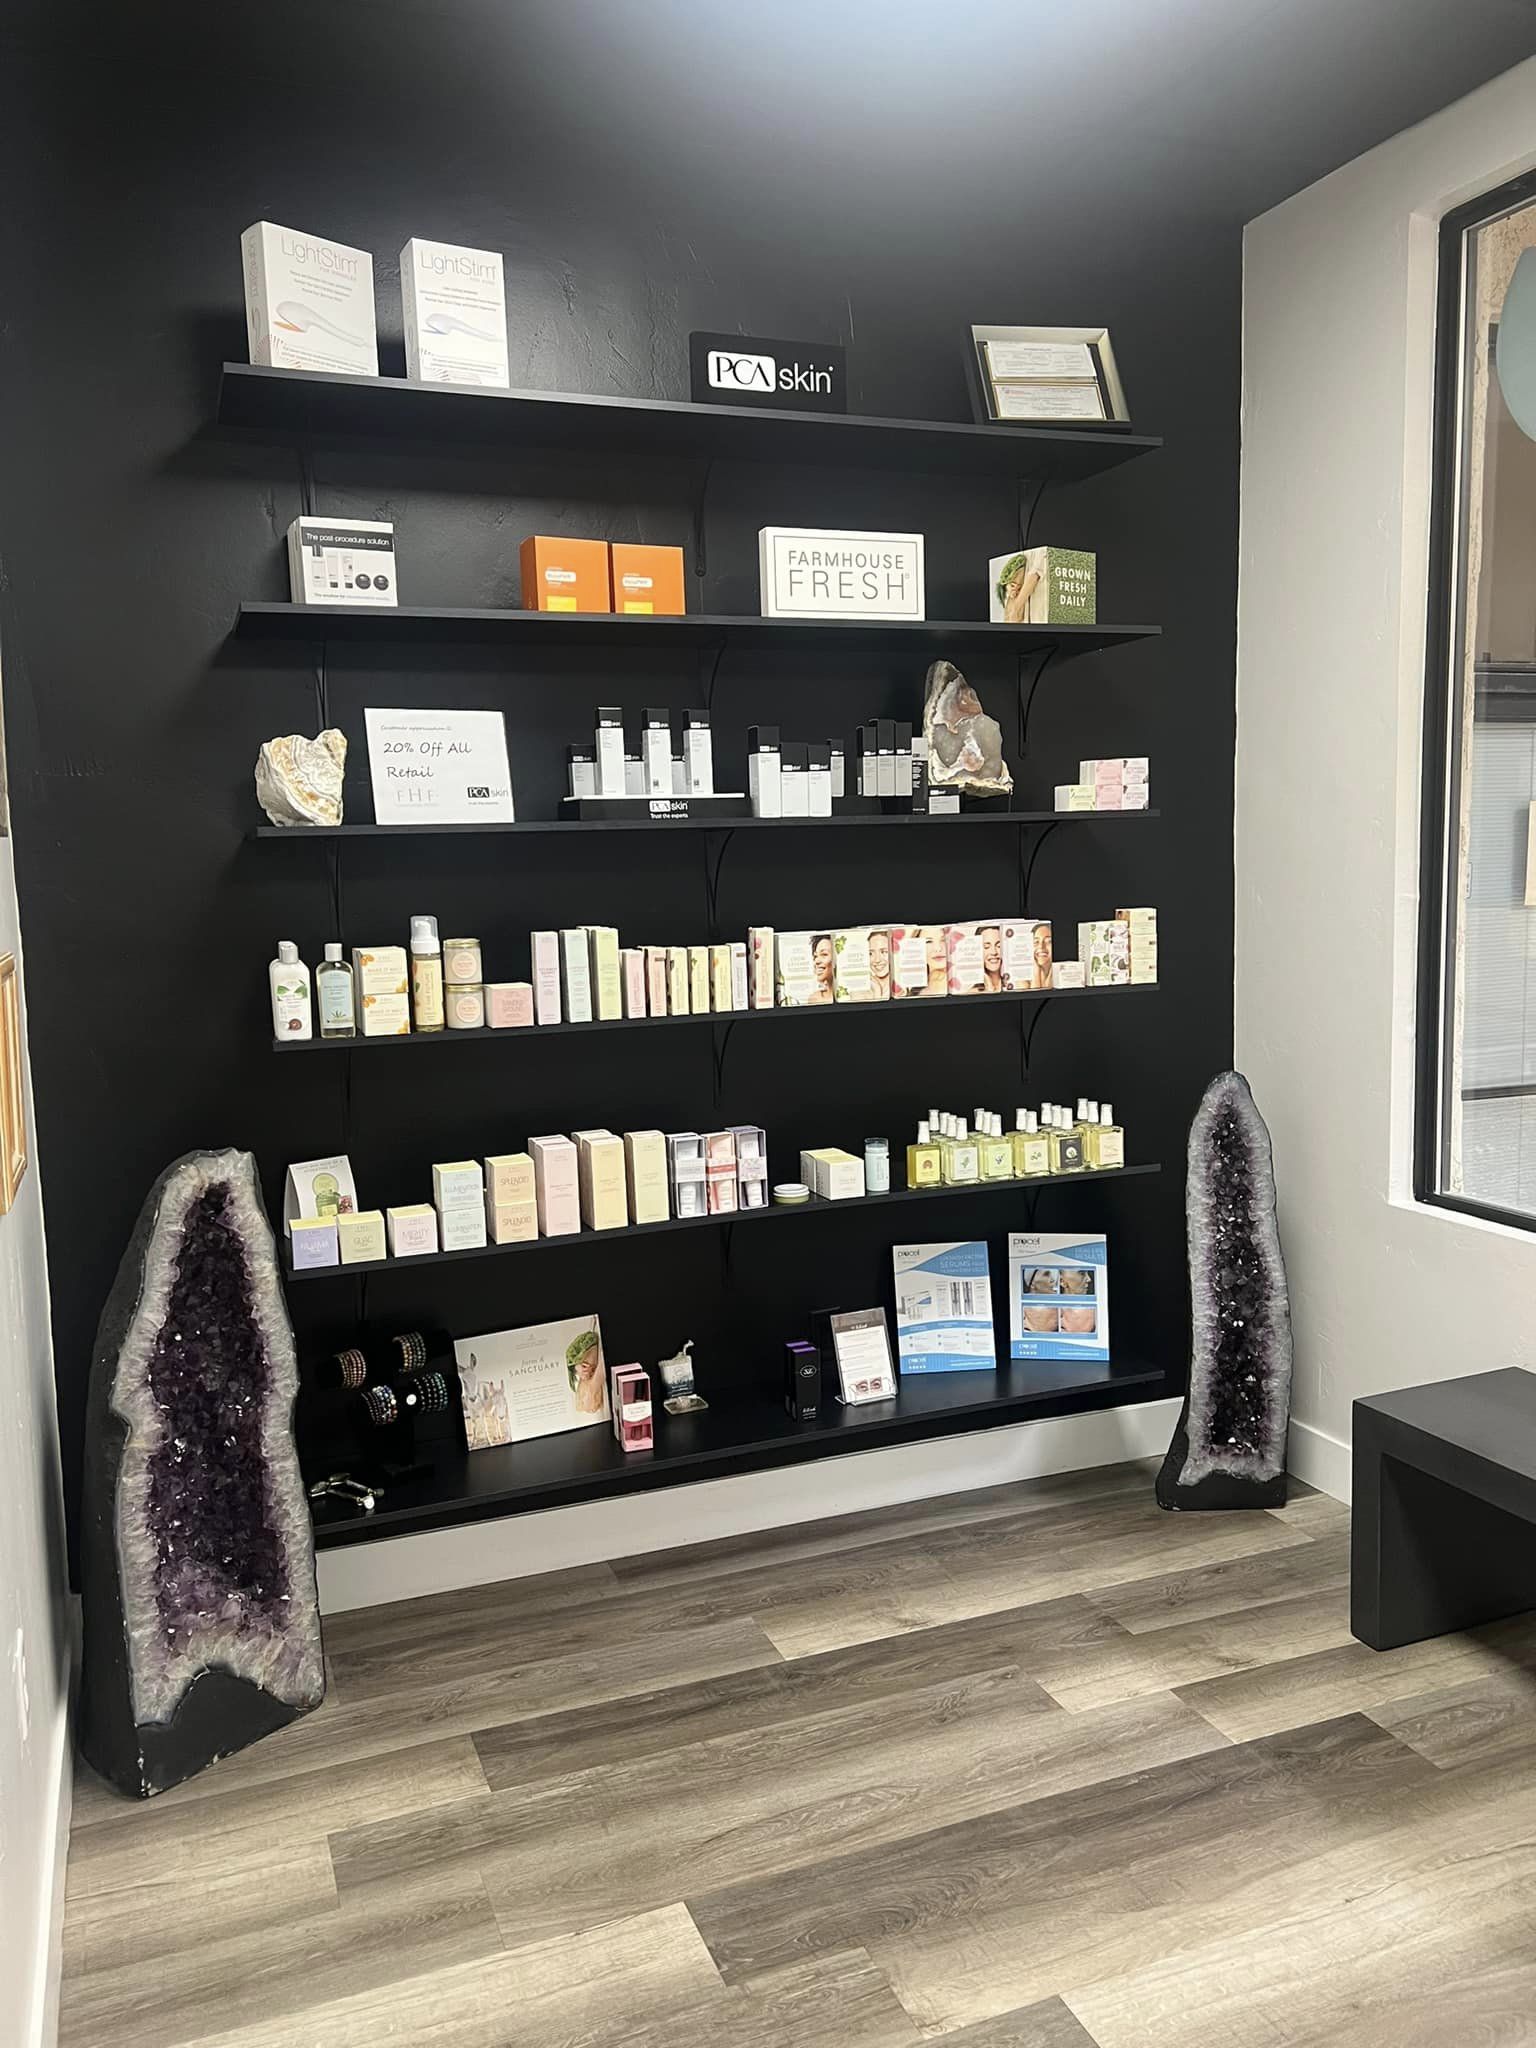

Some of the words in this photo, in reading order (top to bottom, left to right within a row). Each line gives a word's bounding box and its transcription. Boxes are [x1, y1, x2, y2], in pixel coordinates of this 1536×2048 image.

[281, 235, 358, 275] LightStim
[421, 250, 497, 281] LightStim
[715, 356, 772, 388] PCA
[779, 362, 833, 394] skin
[335, 536, 366, 545] procedure
[788, 550, 905, 570] FARMHOUSE
[1054, 566, 1091, 581] GROWN
[789, 569, 905, 601] FRESH
[1060, 580, 1087, 594] FRESH
[1060, 594, 1087, 607] DAILY
[383, 742, 415, 754] 20%
[420, 742, 444, 758] Off
[447, 742, 473, 755] All
[386, 766, 435, 779] Retail
[671, 801, 688, 811] skin
[508, 1362, 560, 1377] SANCTUARY
